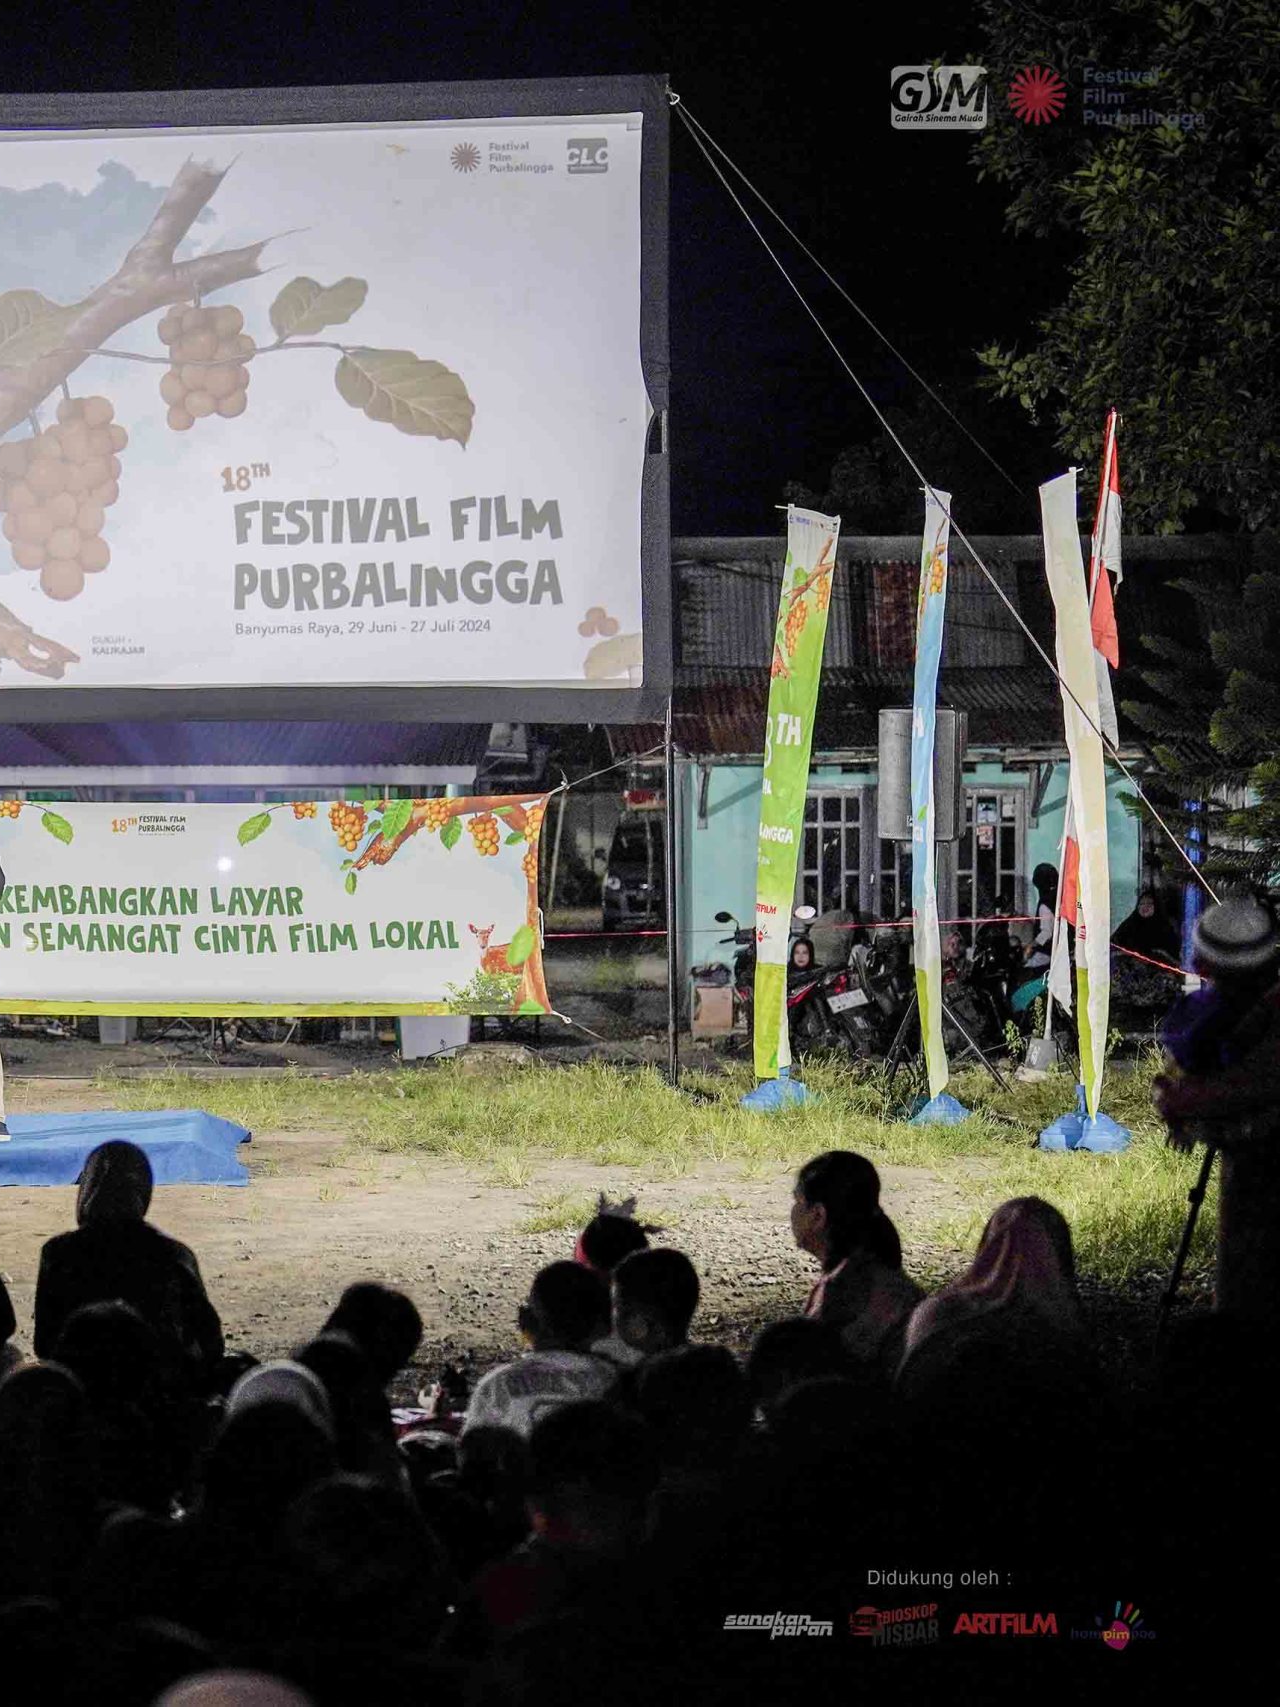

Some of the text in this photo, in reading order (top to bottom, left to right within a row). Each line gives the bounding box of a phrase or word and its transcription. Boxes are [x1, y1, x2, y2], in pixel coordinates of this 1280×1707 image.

[488, 152, 512, 162] Film
[233, 494, 564, 546] FESTIVAL FILM
[233, 559, 564, 612] PURBALINGGA
[235, 622, 304, 638] Banyumas
[308, 622, 345, 637] Raya,
[348, 621, 365, 634] 29
[369, 621, 398, 634] Juni
[411, 620, 426, 633] 27
[431, 620, 455, 633] Juli
[459, 619, 492, 633] 2024
[138, 815, 187, 823] FESTIVAL FILM
[138, 824, 186, 833] PURBALINGGA
[209, 886, 304, 917] LAYAR
[22, 921, 182, 953] SEMANGAT
[368, 919, 460, 950] LOKAL
